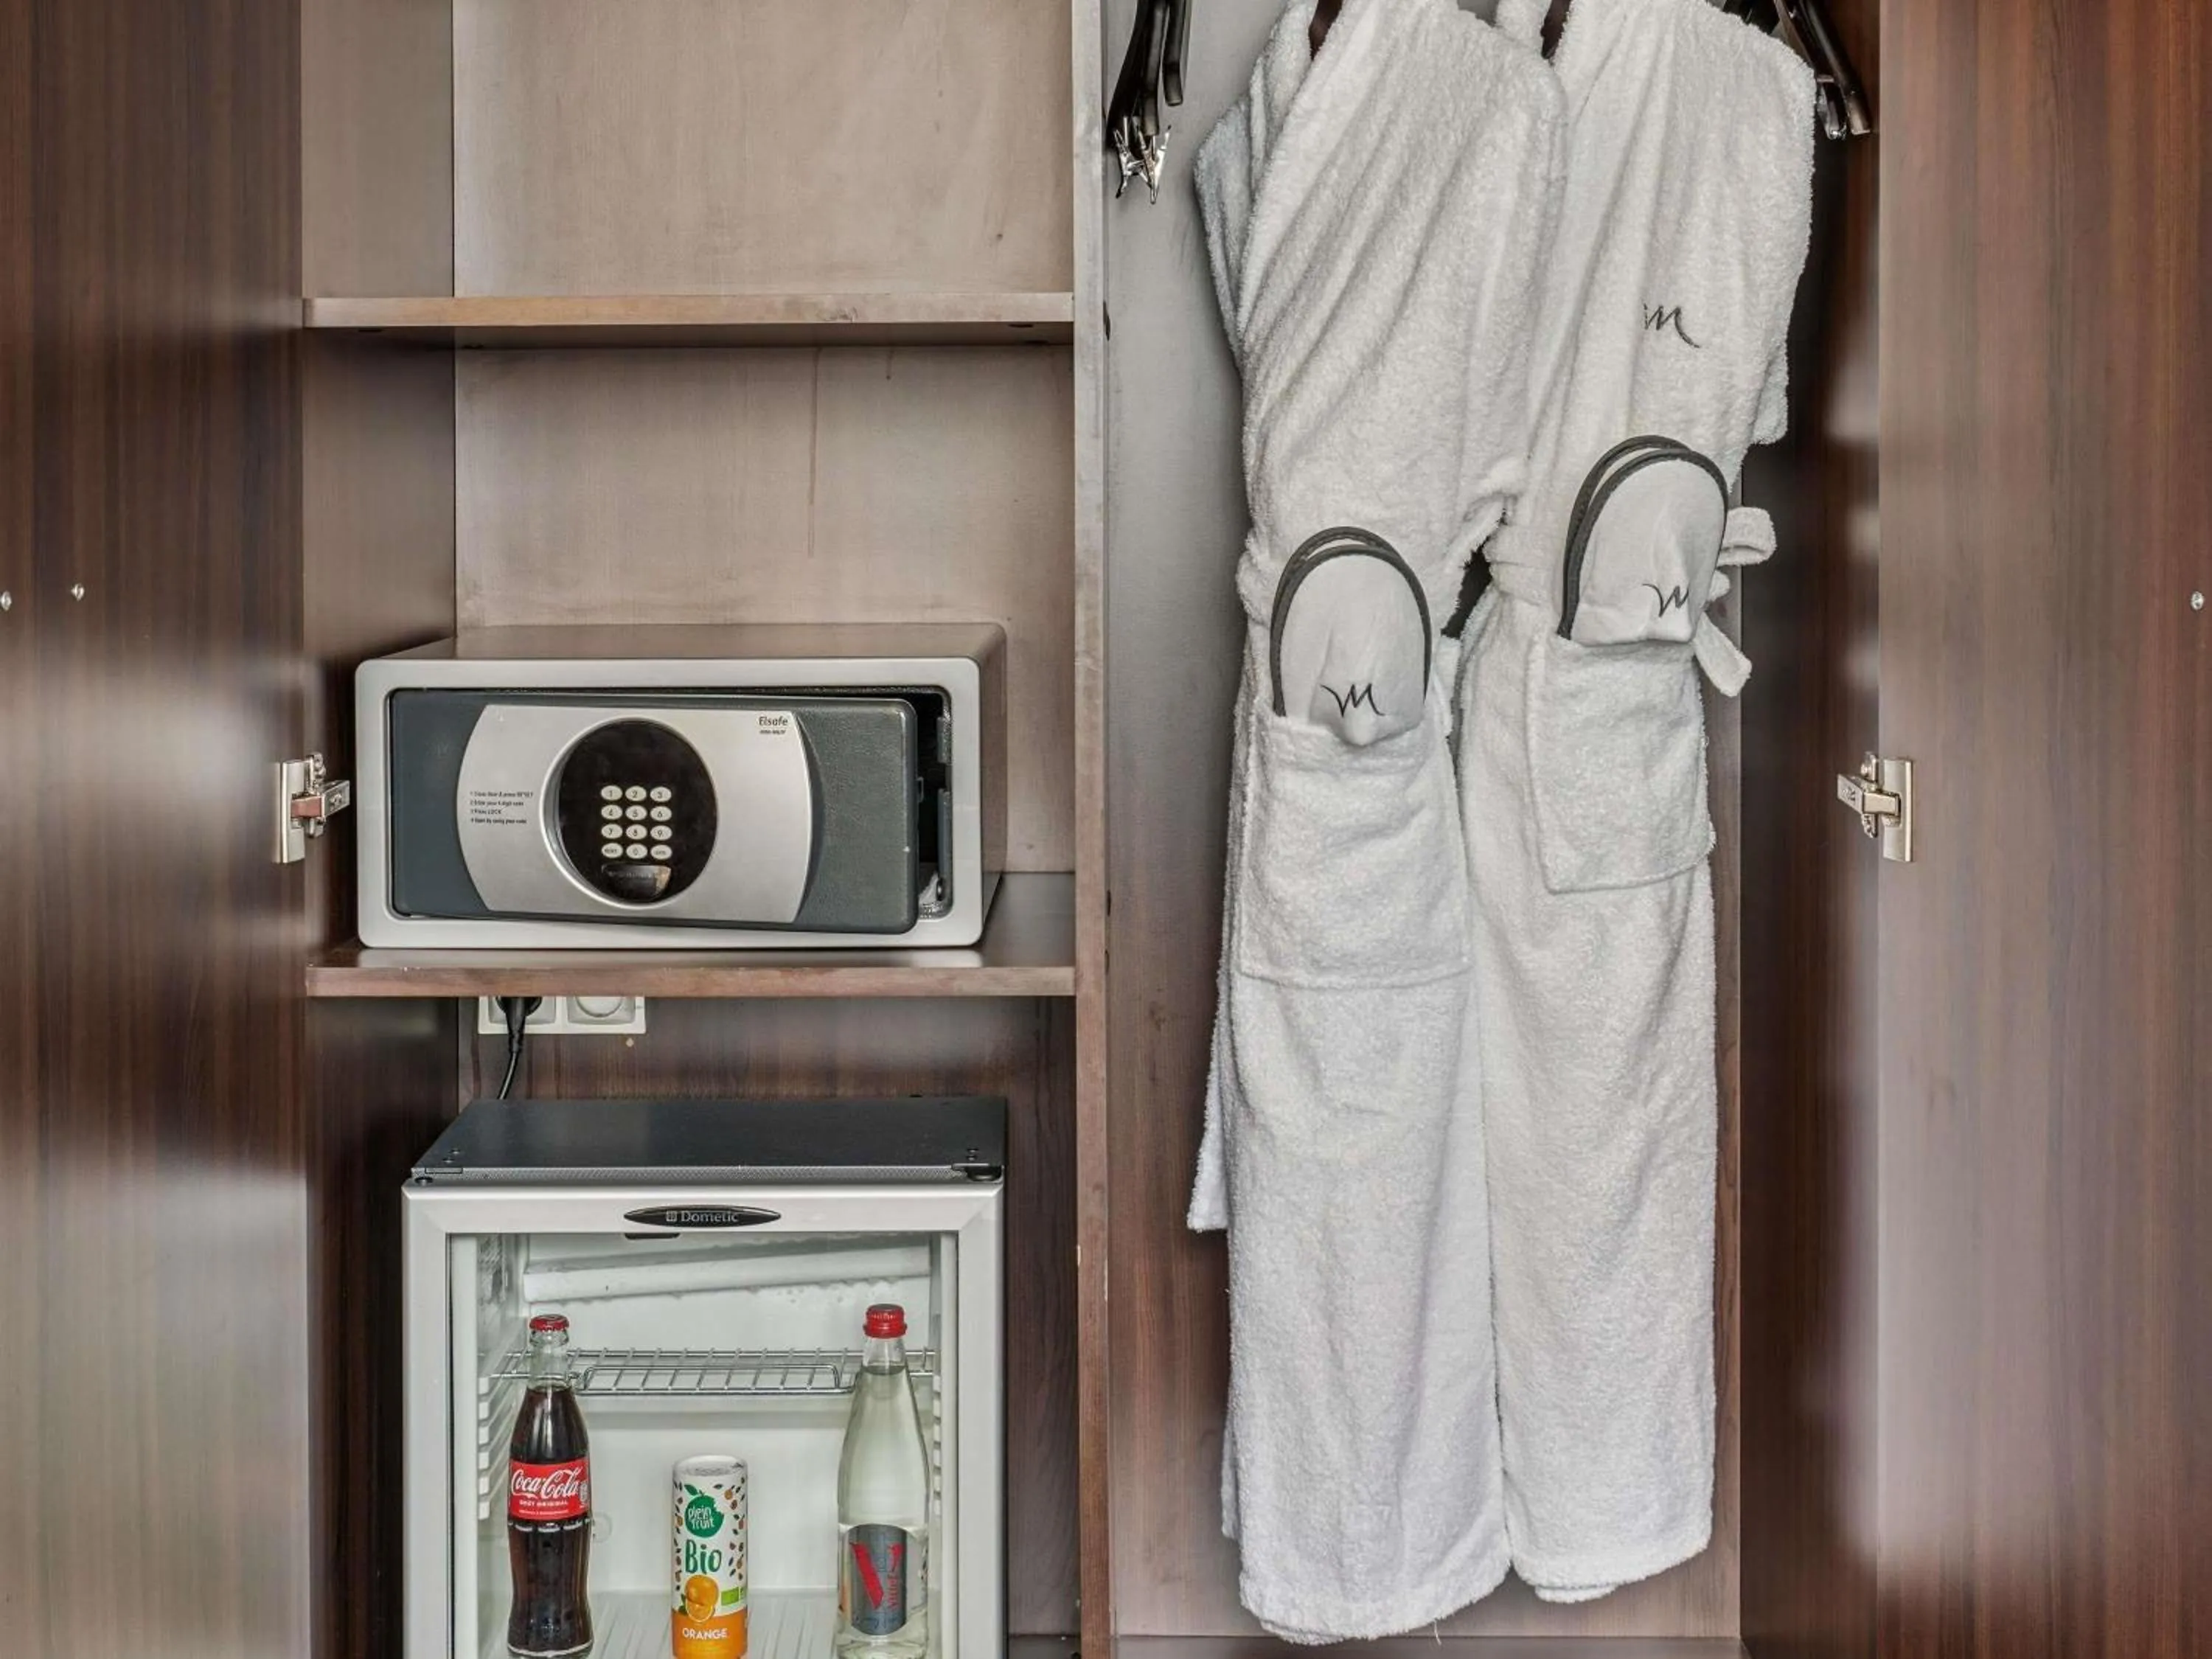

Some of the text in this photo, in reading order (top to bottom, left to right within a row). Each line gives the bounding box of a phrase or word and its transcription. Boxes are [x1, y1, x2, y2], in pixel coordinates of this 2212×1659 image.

[681, 1210, 739, 1222] Dometic
[685, 1539, 722, 1574] Bio
[683, 1627, 728, 1640] ORANGE
